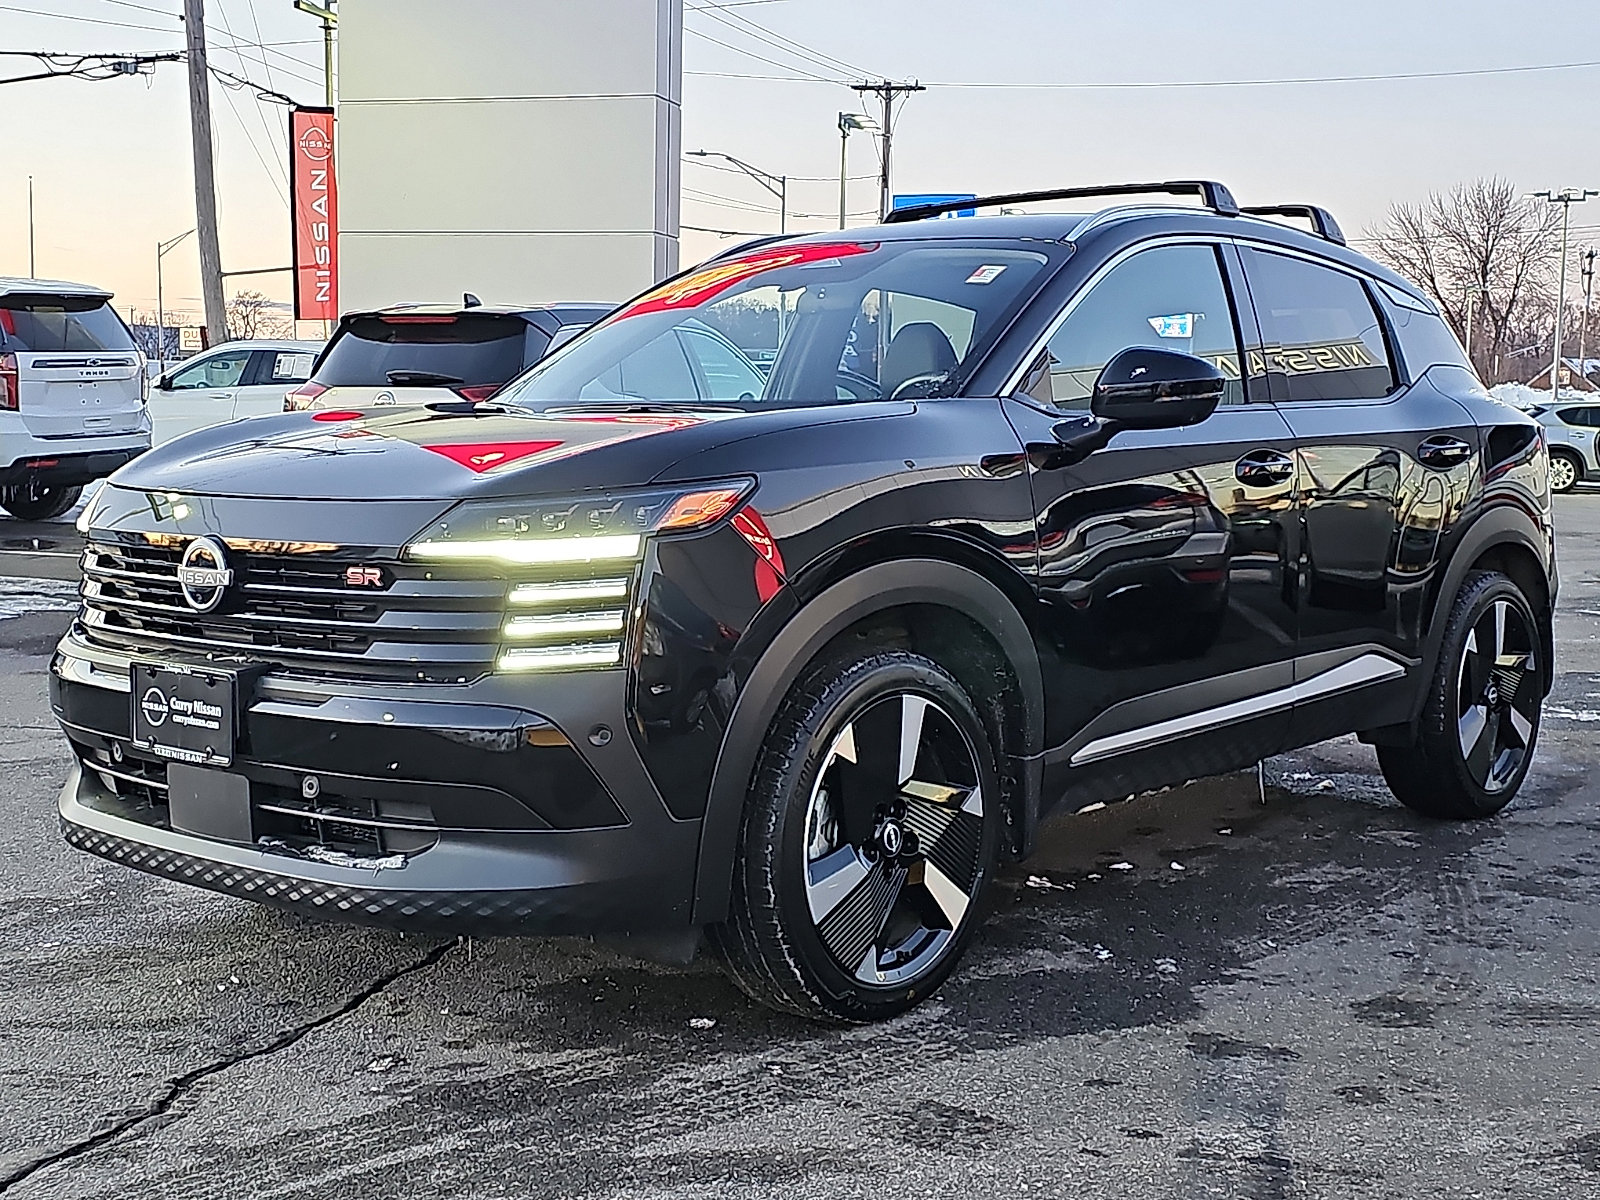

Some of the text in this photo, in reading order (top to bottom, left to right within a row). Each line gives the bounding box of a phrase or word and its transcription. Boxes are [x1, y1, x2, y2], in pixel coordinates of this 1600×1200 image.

[299, 140, 331, 149] NISSN
[310, 169, 330, 302] NISSAN
[178, 569, 230, 586] NISSAN
[346, 566, 384, 587] SR
[169, 696, 222, 718] Curry Nissan
